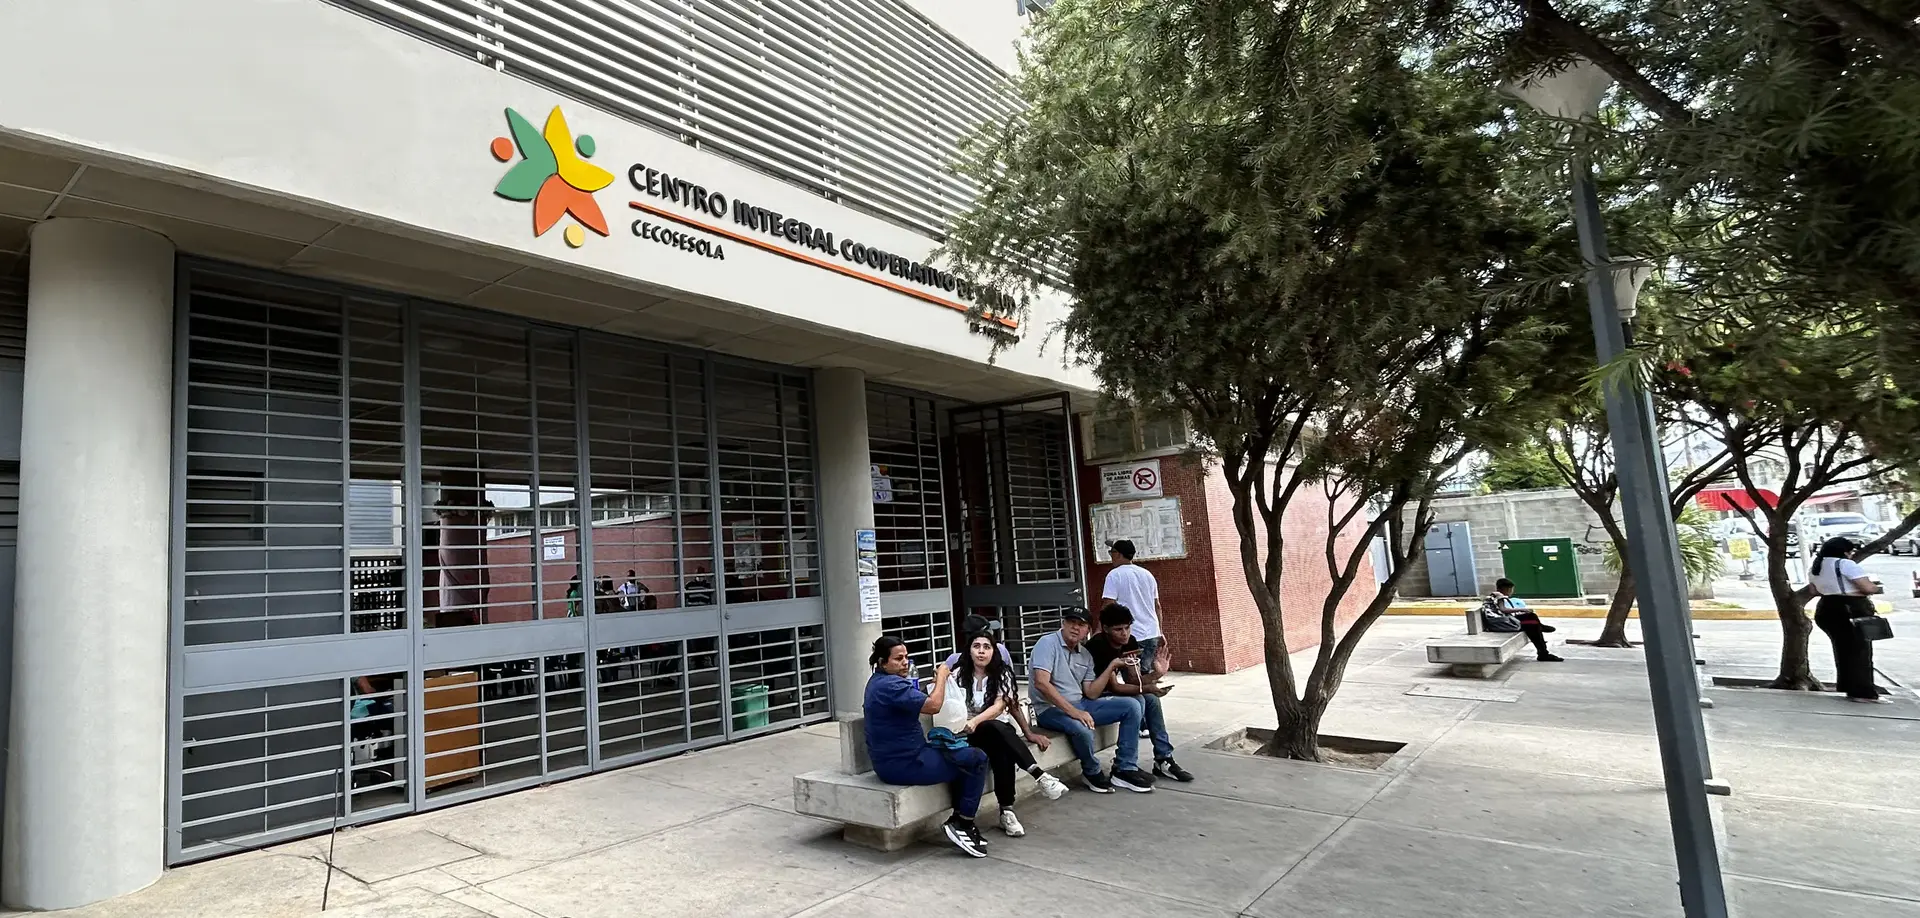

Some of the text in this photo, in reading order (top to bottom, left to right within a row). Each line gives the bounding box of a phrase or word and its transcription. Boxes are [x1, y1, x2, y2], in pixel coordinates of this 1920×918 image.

[628, 163, 727, 217] CENTRO
[733, 198, 838, 256] INTEGRAL
[841, 239, 955, 292] COOPERATIVO
[631, 219, 724, 260] CECOSESOLA
